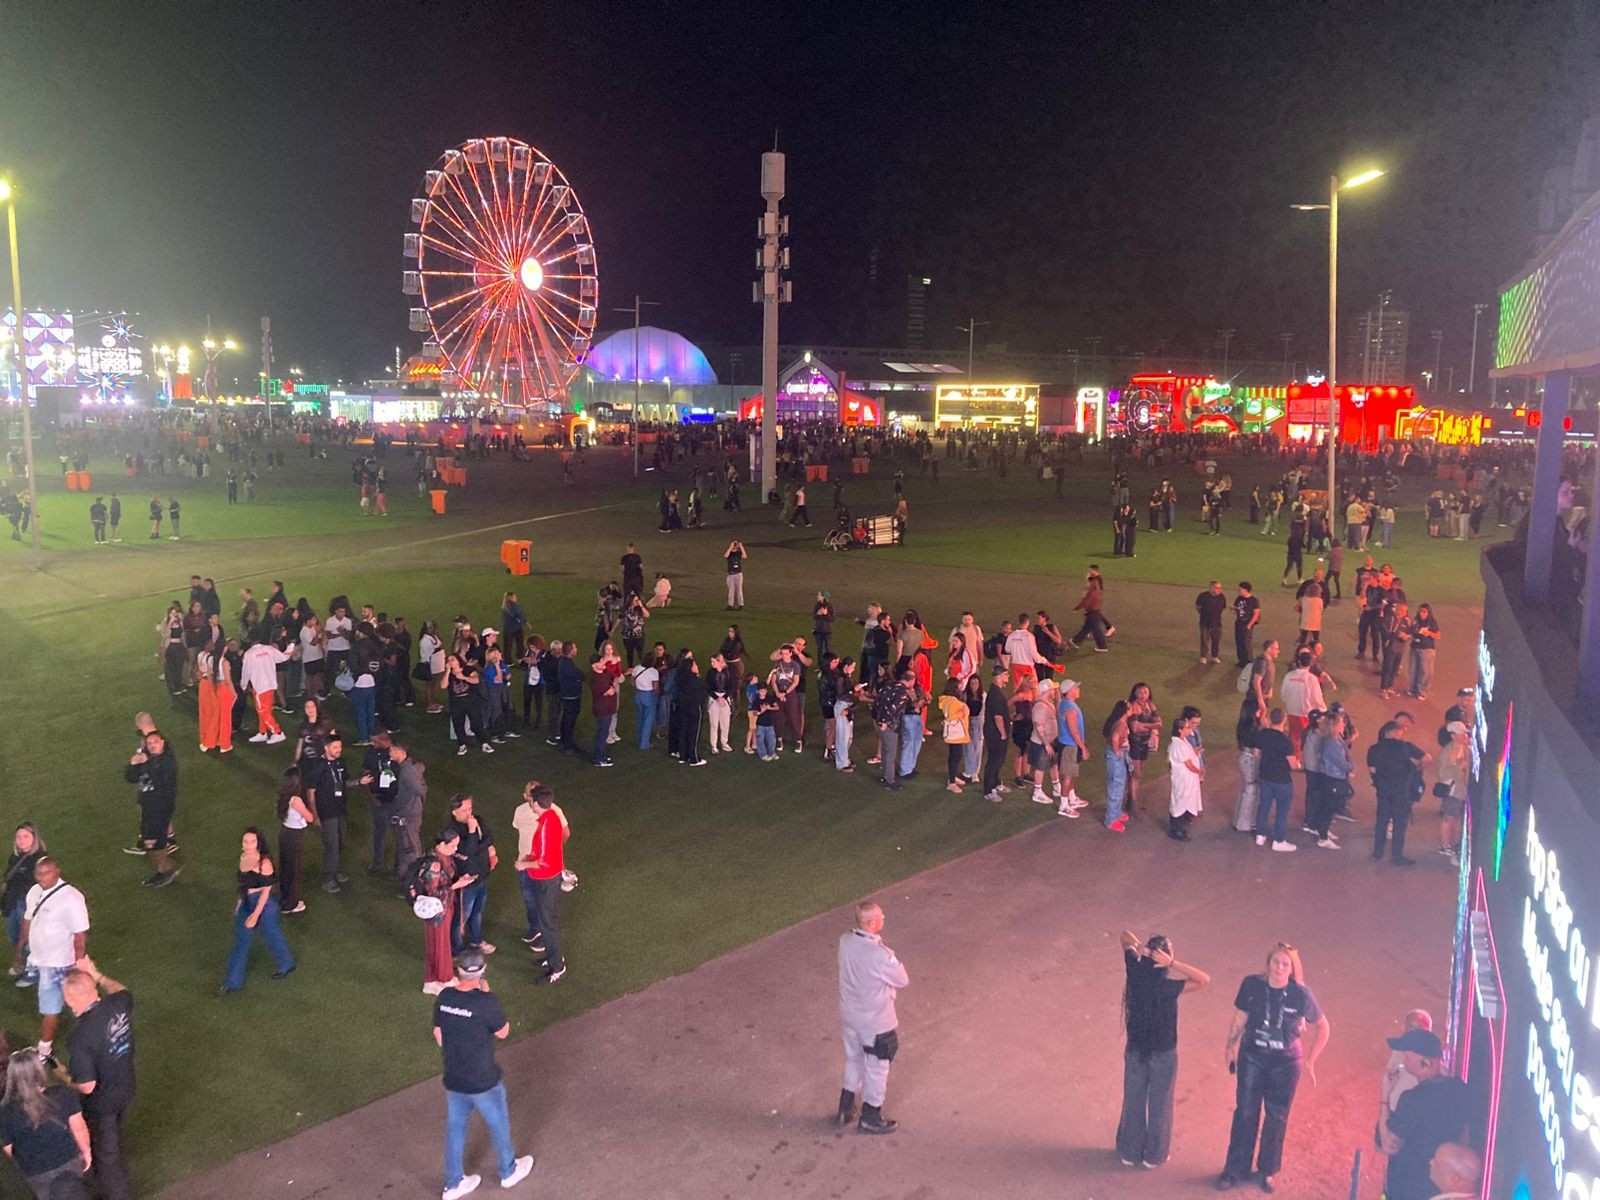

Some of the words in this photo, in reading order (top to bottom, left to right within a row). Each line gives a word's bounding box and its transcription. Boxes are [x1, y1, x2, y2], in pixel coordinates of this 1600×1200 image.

[1545, 850, 1573, 952] Star
[1569, 927, 1591, 1008] ou
[1551, 997, 1574, 1096] seu
